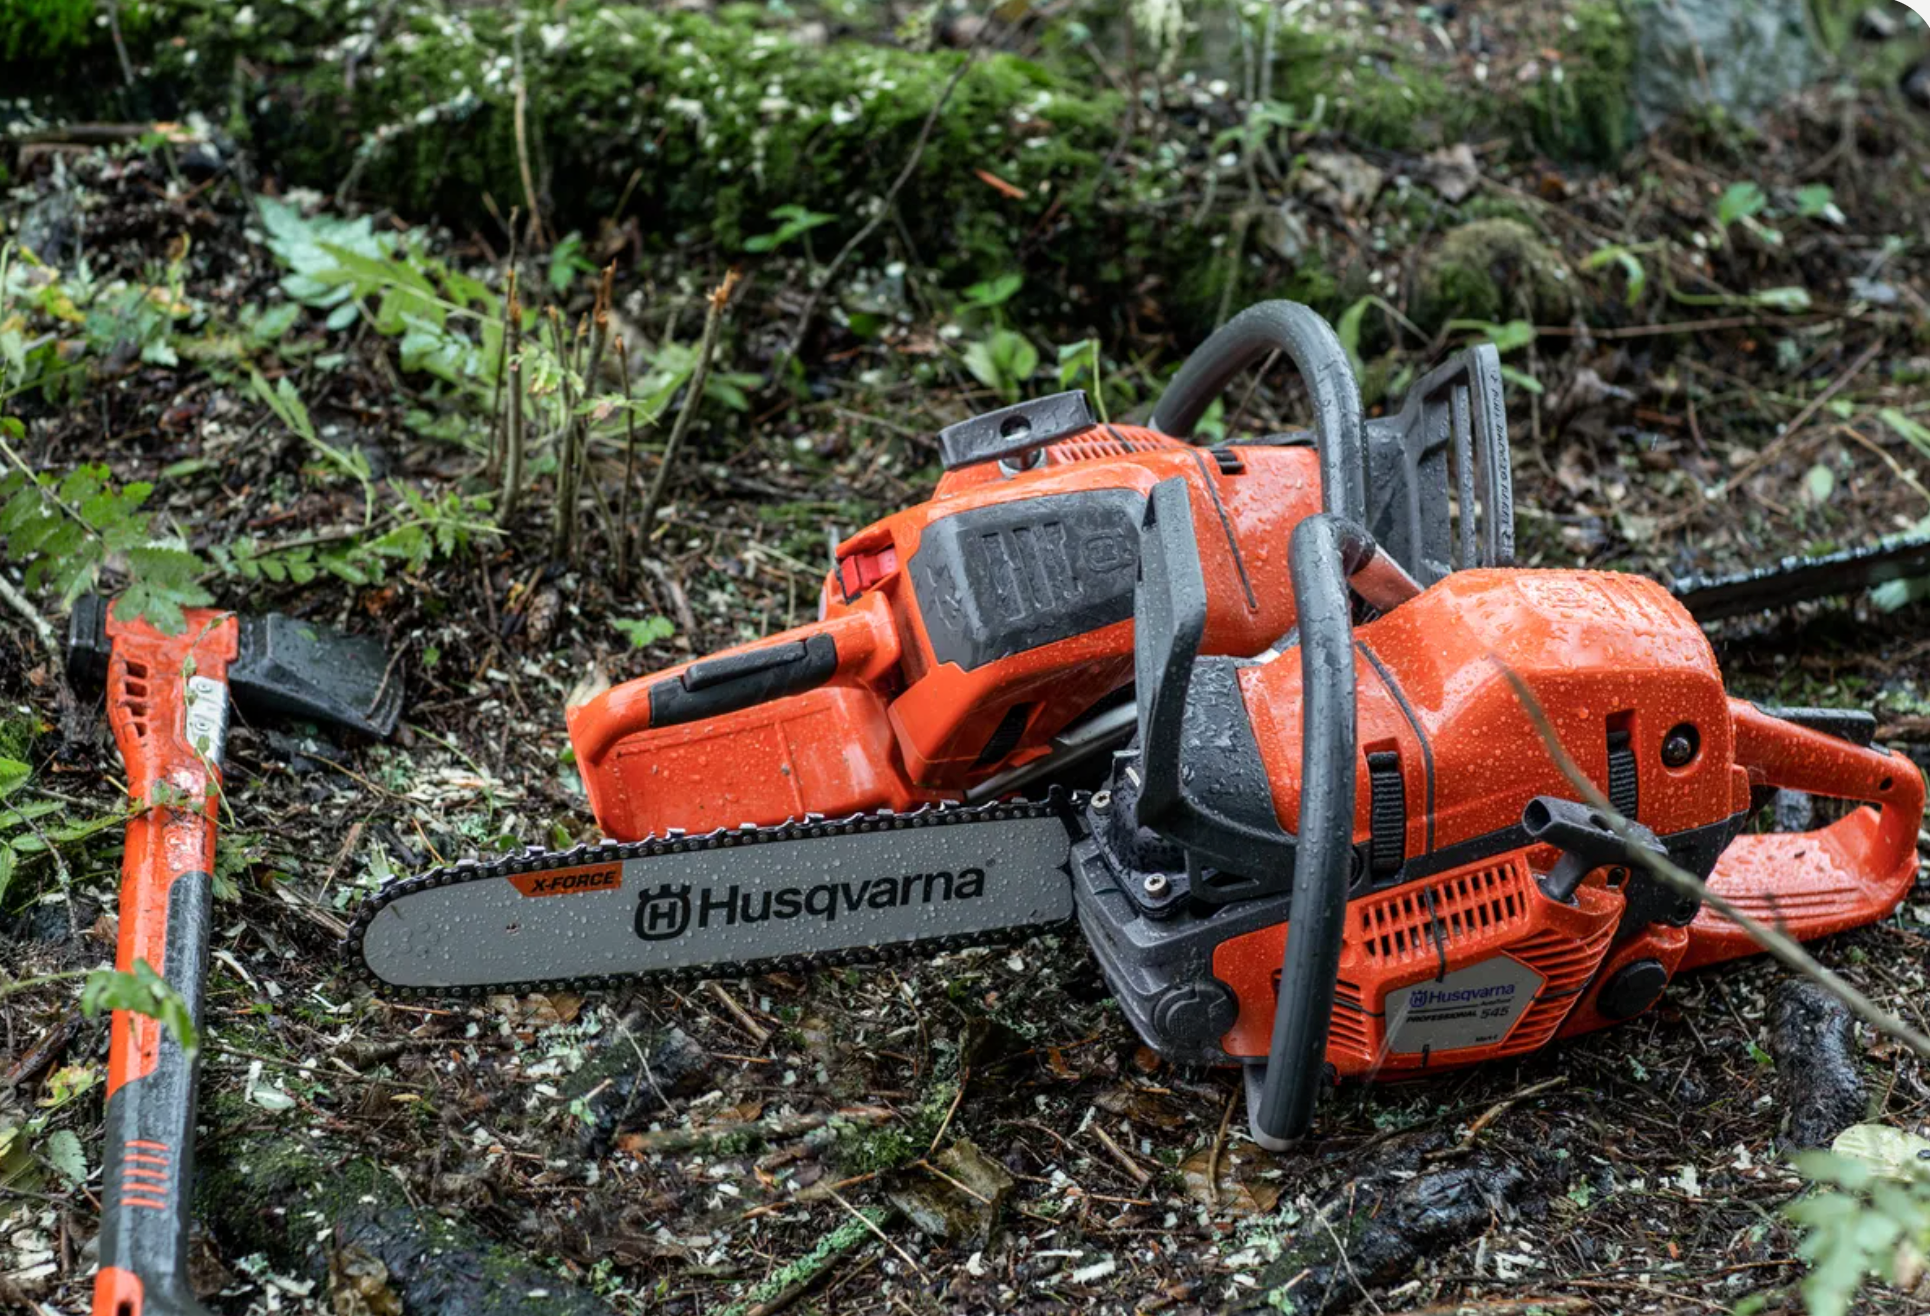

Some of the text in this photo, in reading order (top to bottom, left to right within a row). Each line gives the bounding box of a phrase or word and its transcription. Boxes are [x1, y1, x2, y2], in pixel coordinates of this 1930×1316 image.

[531, 870, 616, 893] X-FORCE
[699, 867, 986, 928] Husqvarna
[1429, 984, 1515, 1005] Husqvarna
[1406, 1006, 1510, 1023] PROFESSIONAL 545
